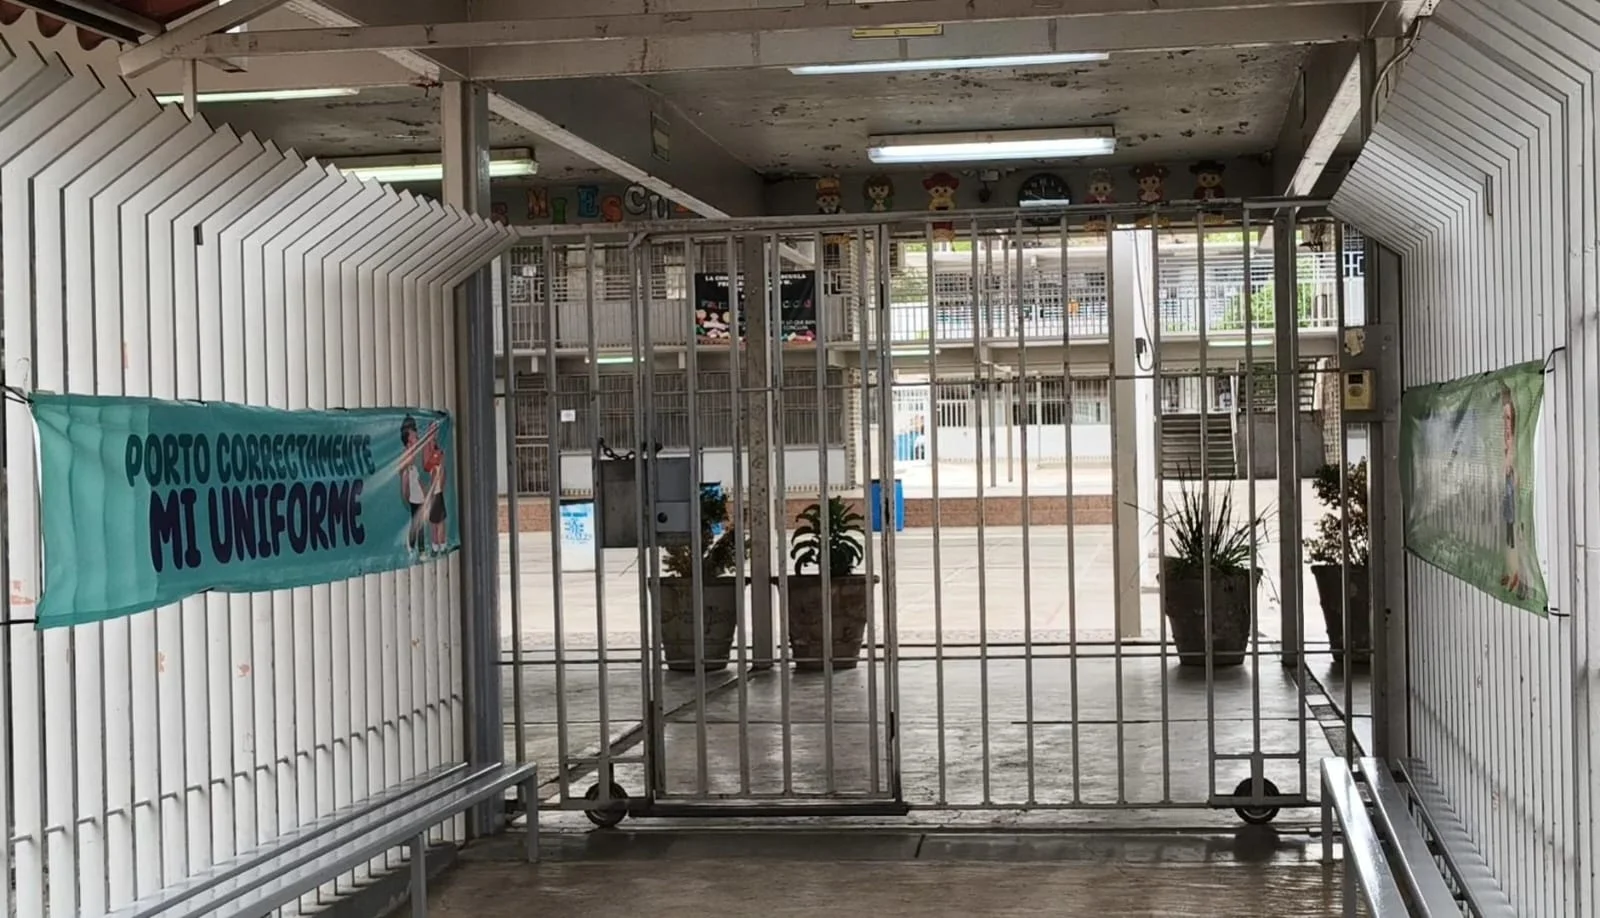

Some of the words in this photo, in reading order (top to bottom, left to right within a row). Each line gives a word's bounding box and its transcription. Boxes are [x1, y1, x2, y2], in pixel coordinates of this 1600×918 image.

[125, 433, 210, 487] PORTO
[216, 433, 374, 483] CORRECTAMENTE
[149, 488, 201, 573] MI
[208, 479, 365, 565] UNIFORME
